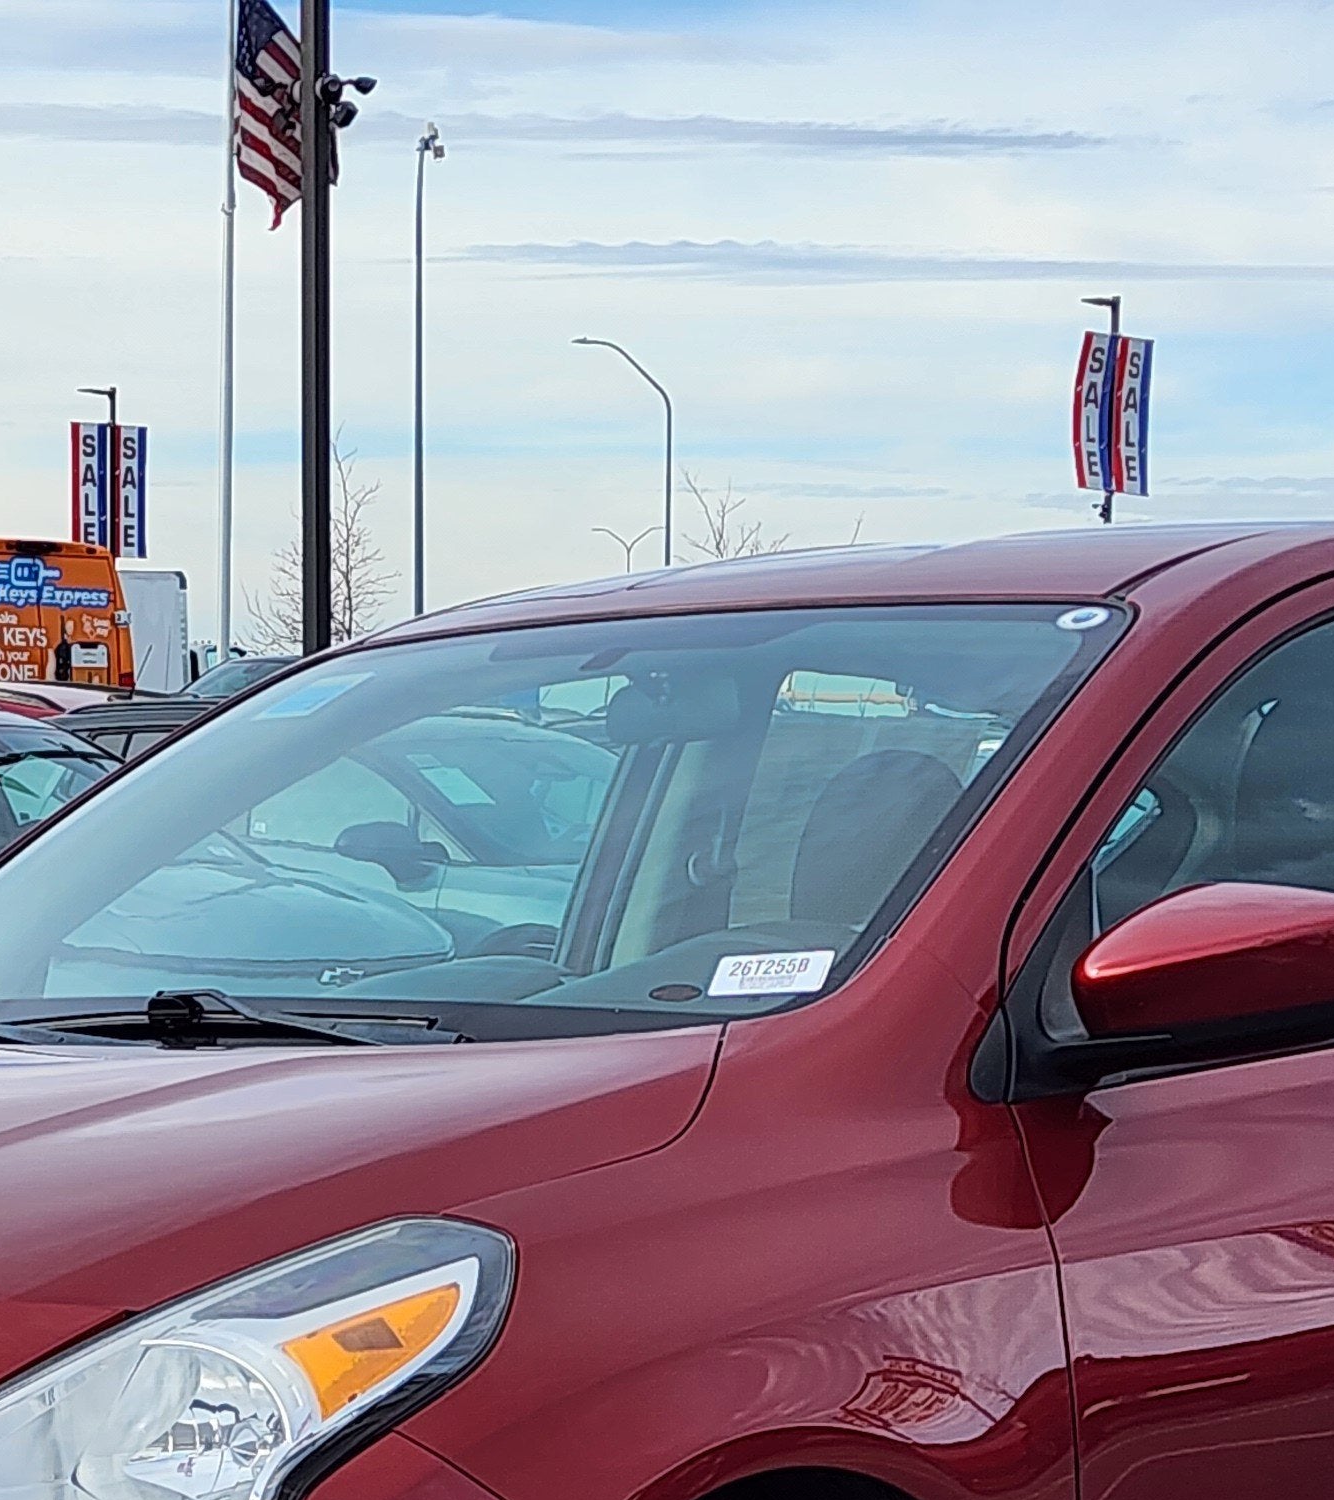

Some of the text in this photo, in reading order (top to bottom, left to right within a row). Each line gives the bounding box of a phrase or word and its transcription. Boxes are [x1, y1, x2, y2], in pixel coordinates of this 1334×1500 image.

[1083, 346, 1106, 478] SALE
[1123, 351, 1142, 482] SALE
[81, 433, 97, 546] SALE
[122, 436, 137, 548] SALE
[2, 627, 48, 647] KEYS
[41, 585, 109, 608] Express
[7, 651, 31, 663] your
